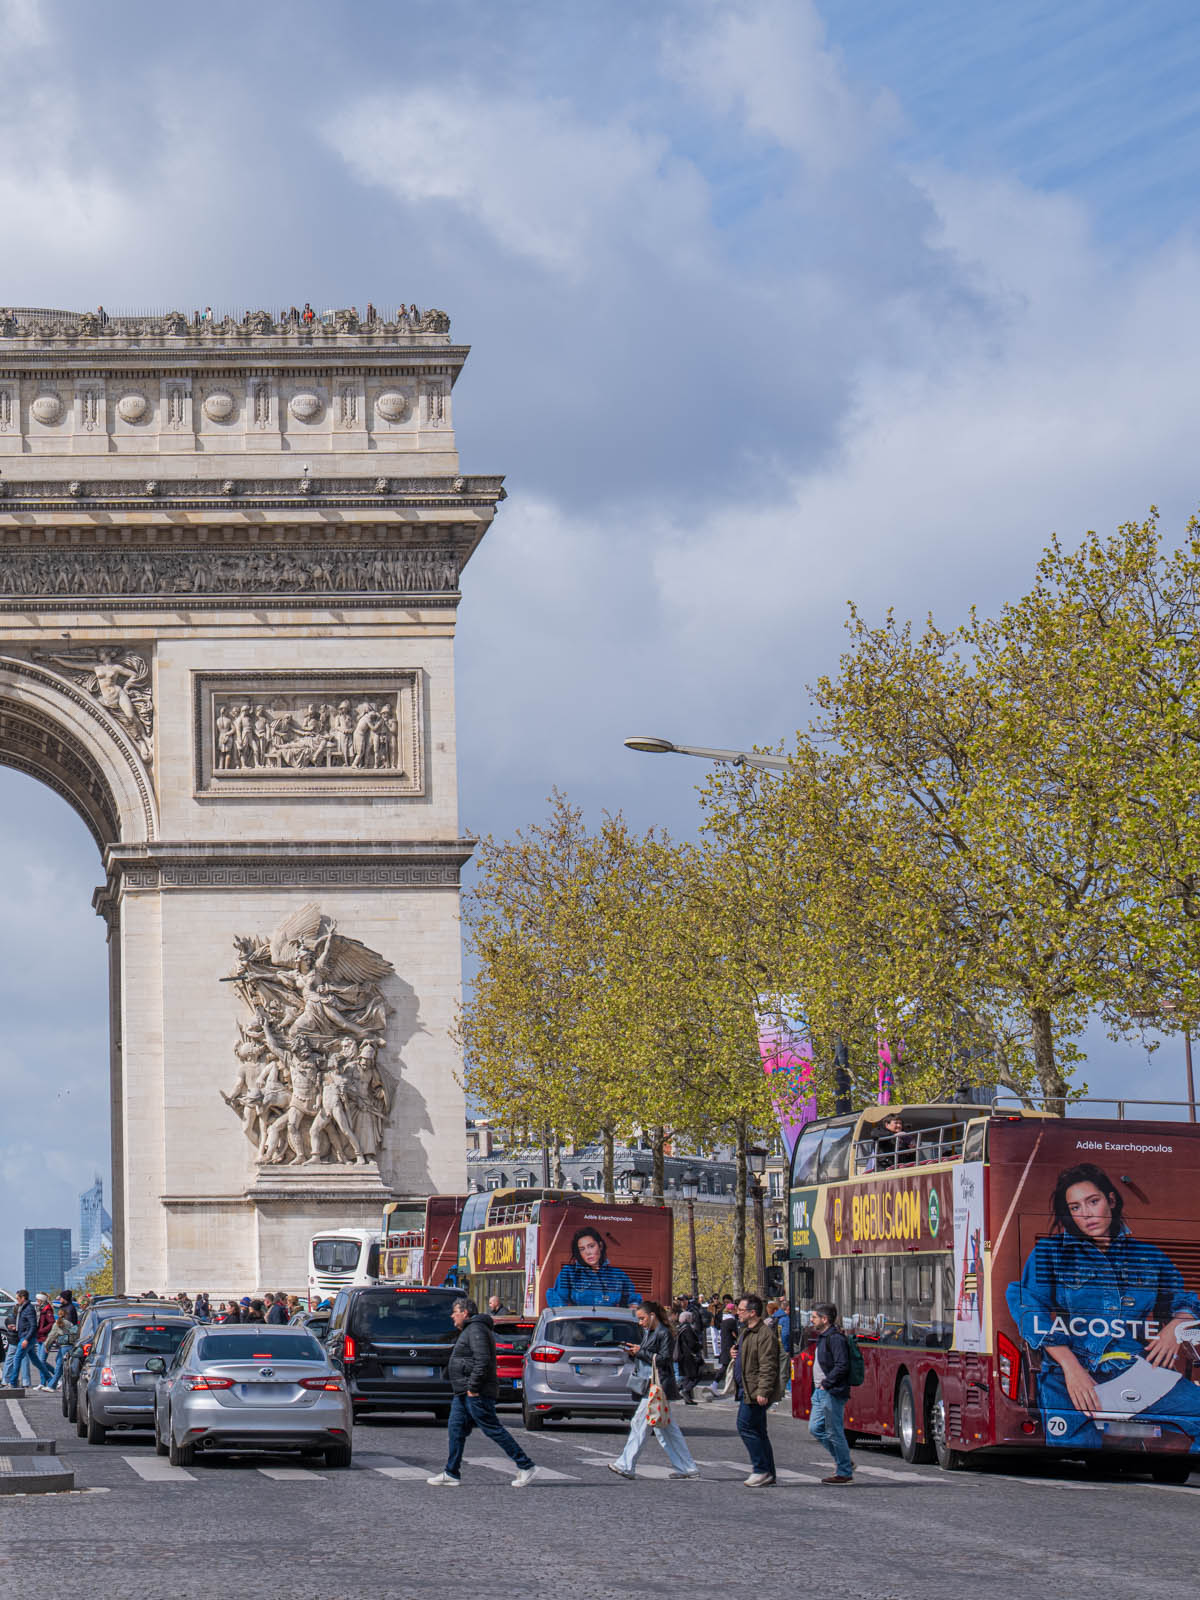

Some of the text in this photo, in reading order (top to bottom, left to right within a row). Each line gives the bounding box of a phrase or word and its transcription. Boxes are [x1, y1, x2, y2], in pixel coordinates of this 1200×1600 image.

[1076, 1140, 1173, 1154] Adèle Exarchopoulos
[852, 1191, 921, 1241] BIGBUS.COM
[1033, 1315, 1161, 1340] LACOSTE
[1049, 1420, 1066, 1432] 70
